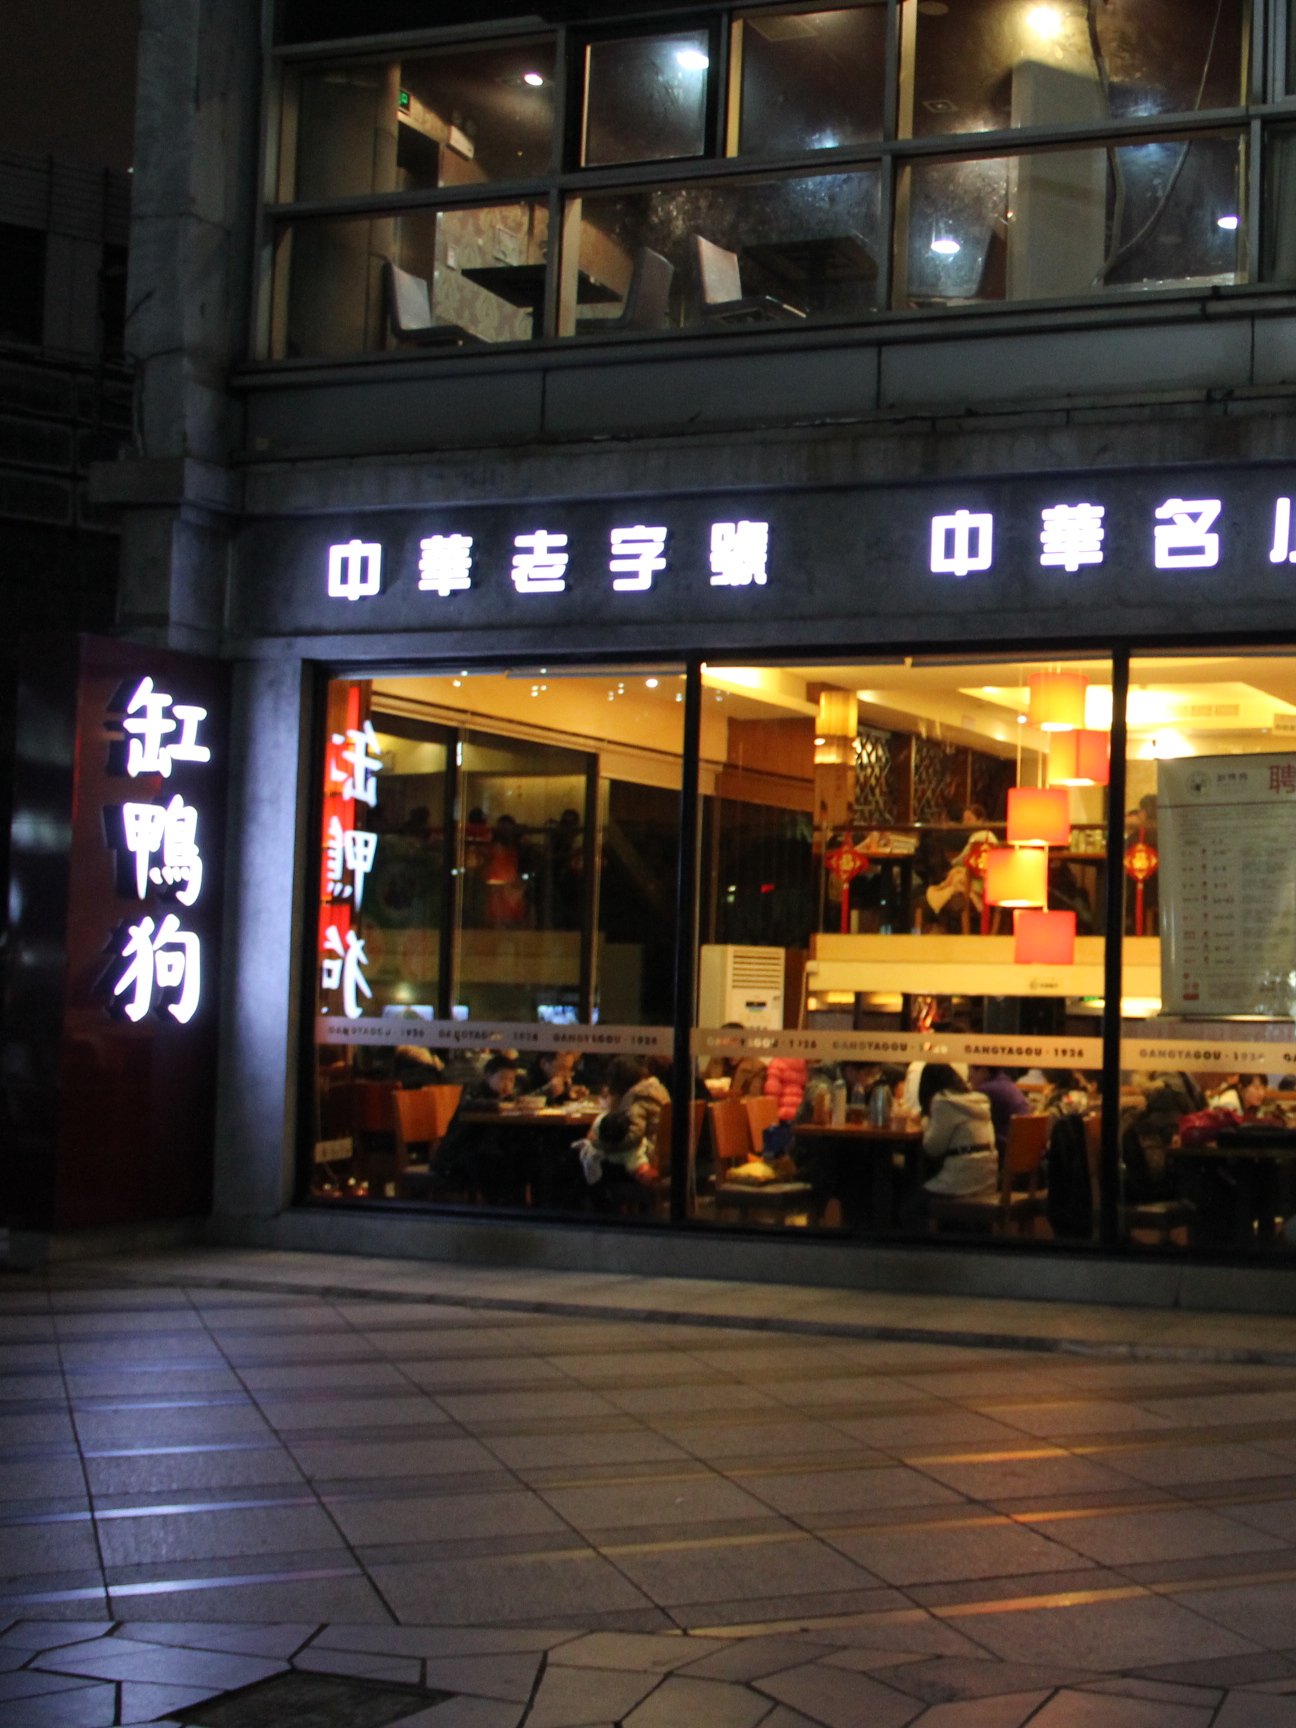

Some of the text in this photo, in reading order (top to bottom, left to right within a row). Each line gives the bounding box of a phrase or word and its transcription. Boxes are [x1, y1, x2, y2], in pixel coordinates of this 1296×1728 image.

[327, 520, 769, 600] 中華老字號
[114, 676, 211, 1024] 缸鴨狗
[438, 1029, 504, 1041] GANGYAG
[706, 1037, 778, 1048] GYGOU
[964, 1044, 1042, 1056] GANGYAGOU
[1054, 1047, 1084, 1058] 1926
[1139, 1049, 1221, 1061] GANGYAGOU
